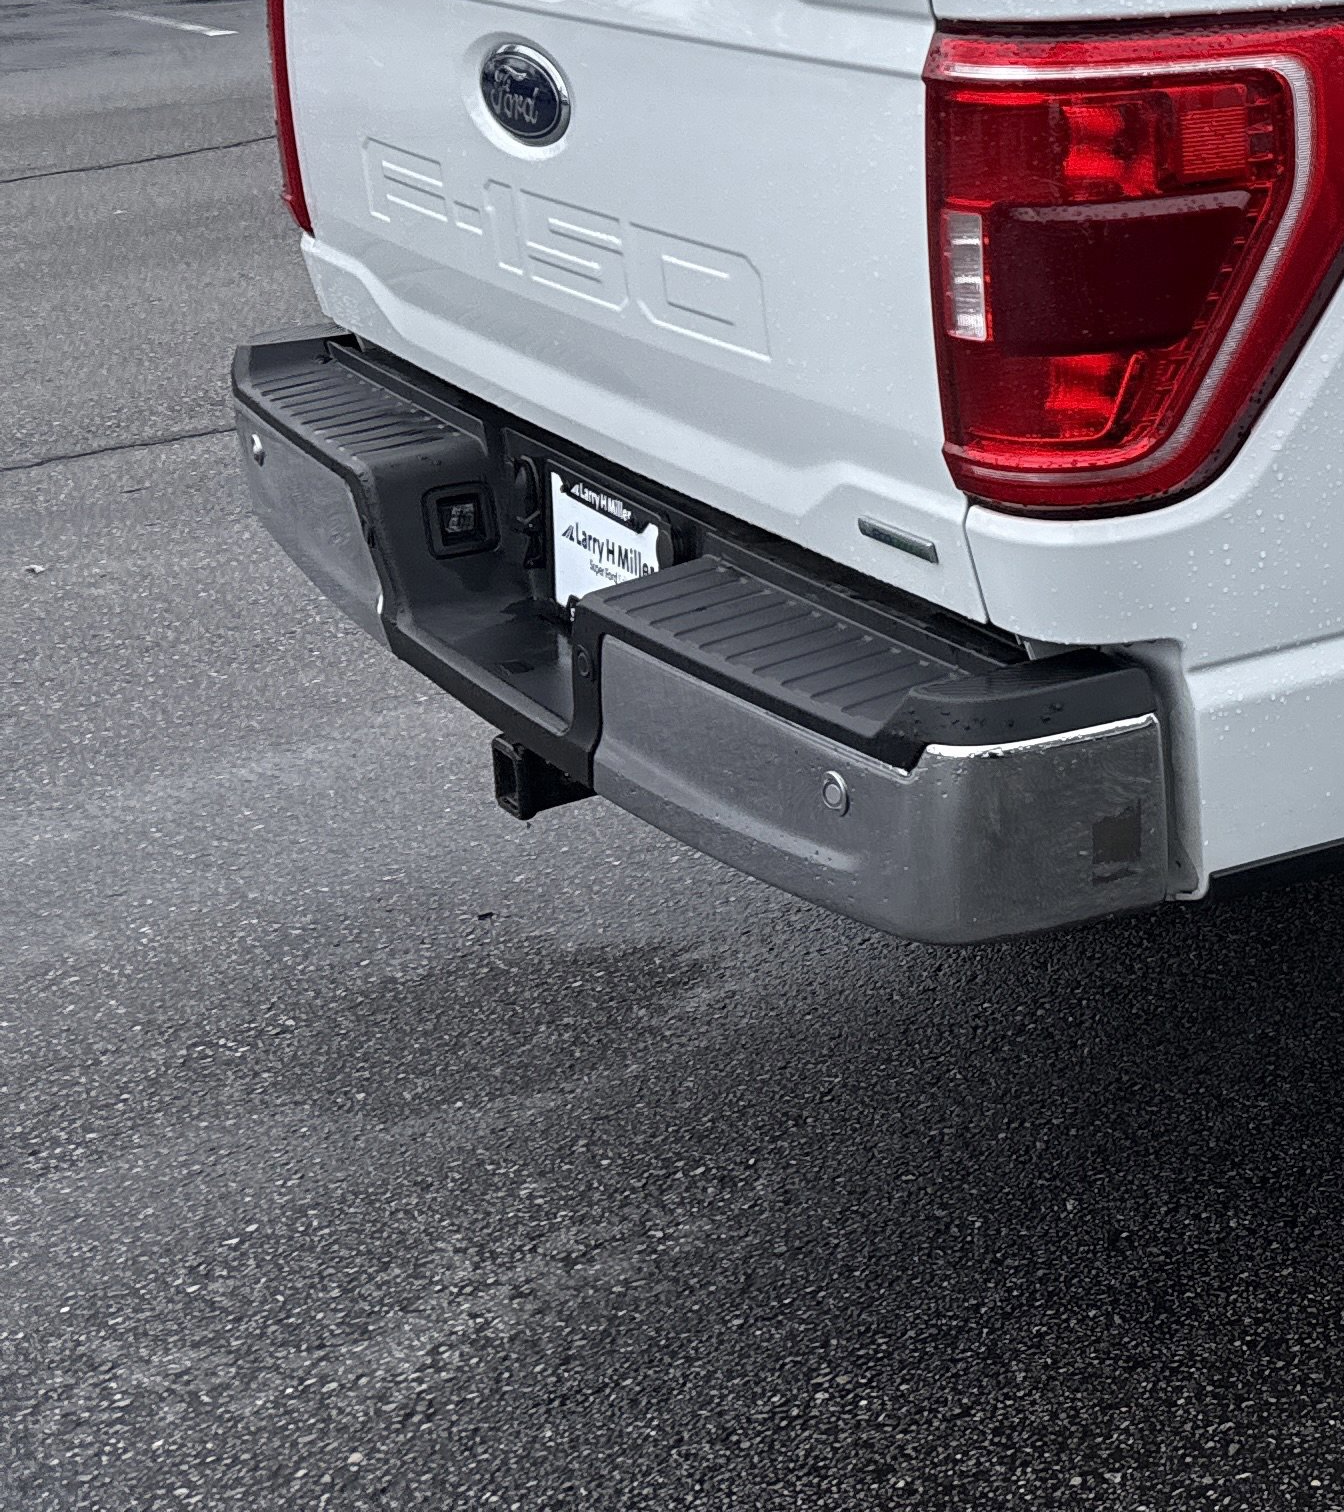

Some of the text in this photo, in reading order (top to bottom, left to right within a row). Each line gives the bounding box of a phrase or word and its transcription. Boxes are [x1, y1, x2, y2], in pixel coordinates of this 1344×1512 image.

[490, 62, 540, 125] Ford
[580, 482, 632, 521] Larry H Miller
[575, 522, 605, 563] Larry
[606, 538, 616, 566] H
